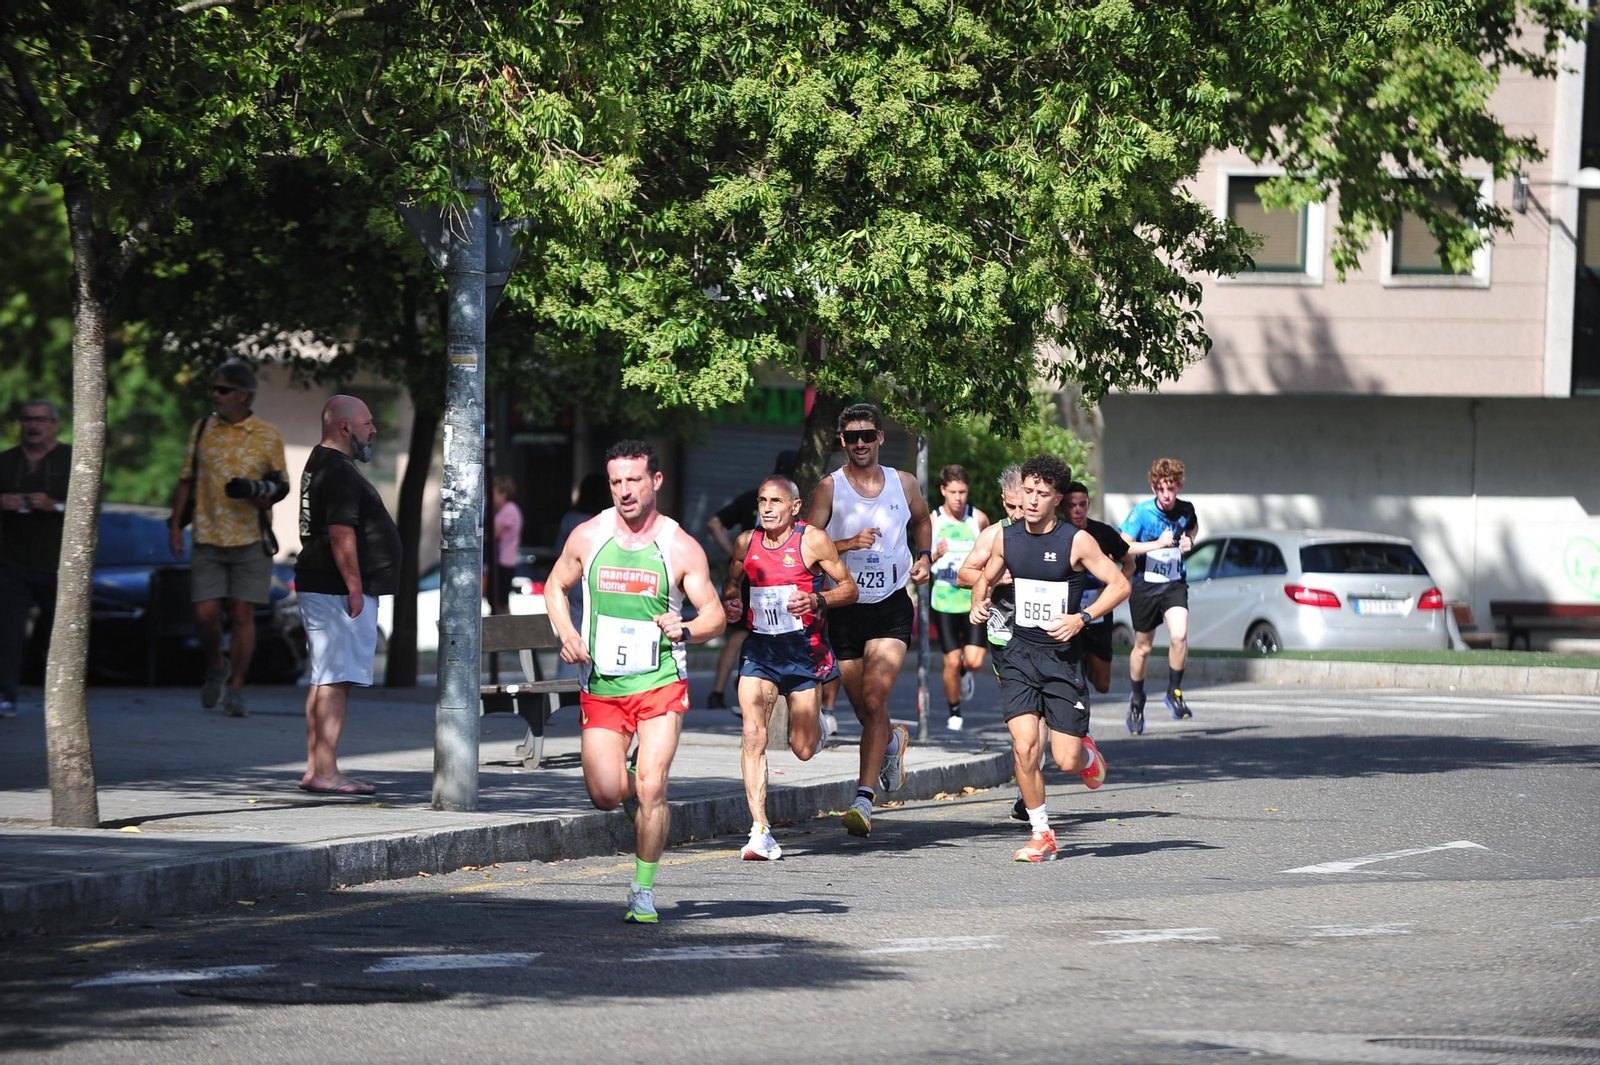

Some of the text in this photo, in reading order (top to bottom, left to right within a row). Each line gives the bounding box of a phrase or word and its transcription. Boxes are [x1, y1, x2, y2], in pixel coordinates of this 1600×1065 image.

[600, 570, 657, 585] mandarina
[1152, 562, 1173, 575] 457
[600, 579, 627, 592] home
[856, 571, 885, 589] 423
[764, 608, 779, 626] 111
[1024, 601, 1051, 621] 685
[616, 645, 628, 666] 5
